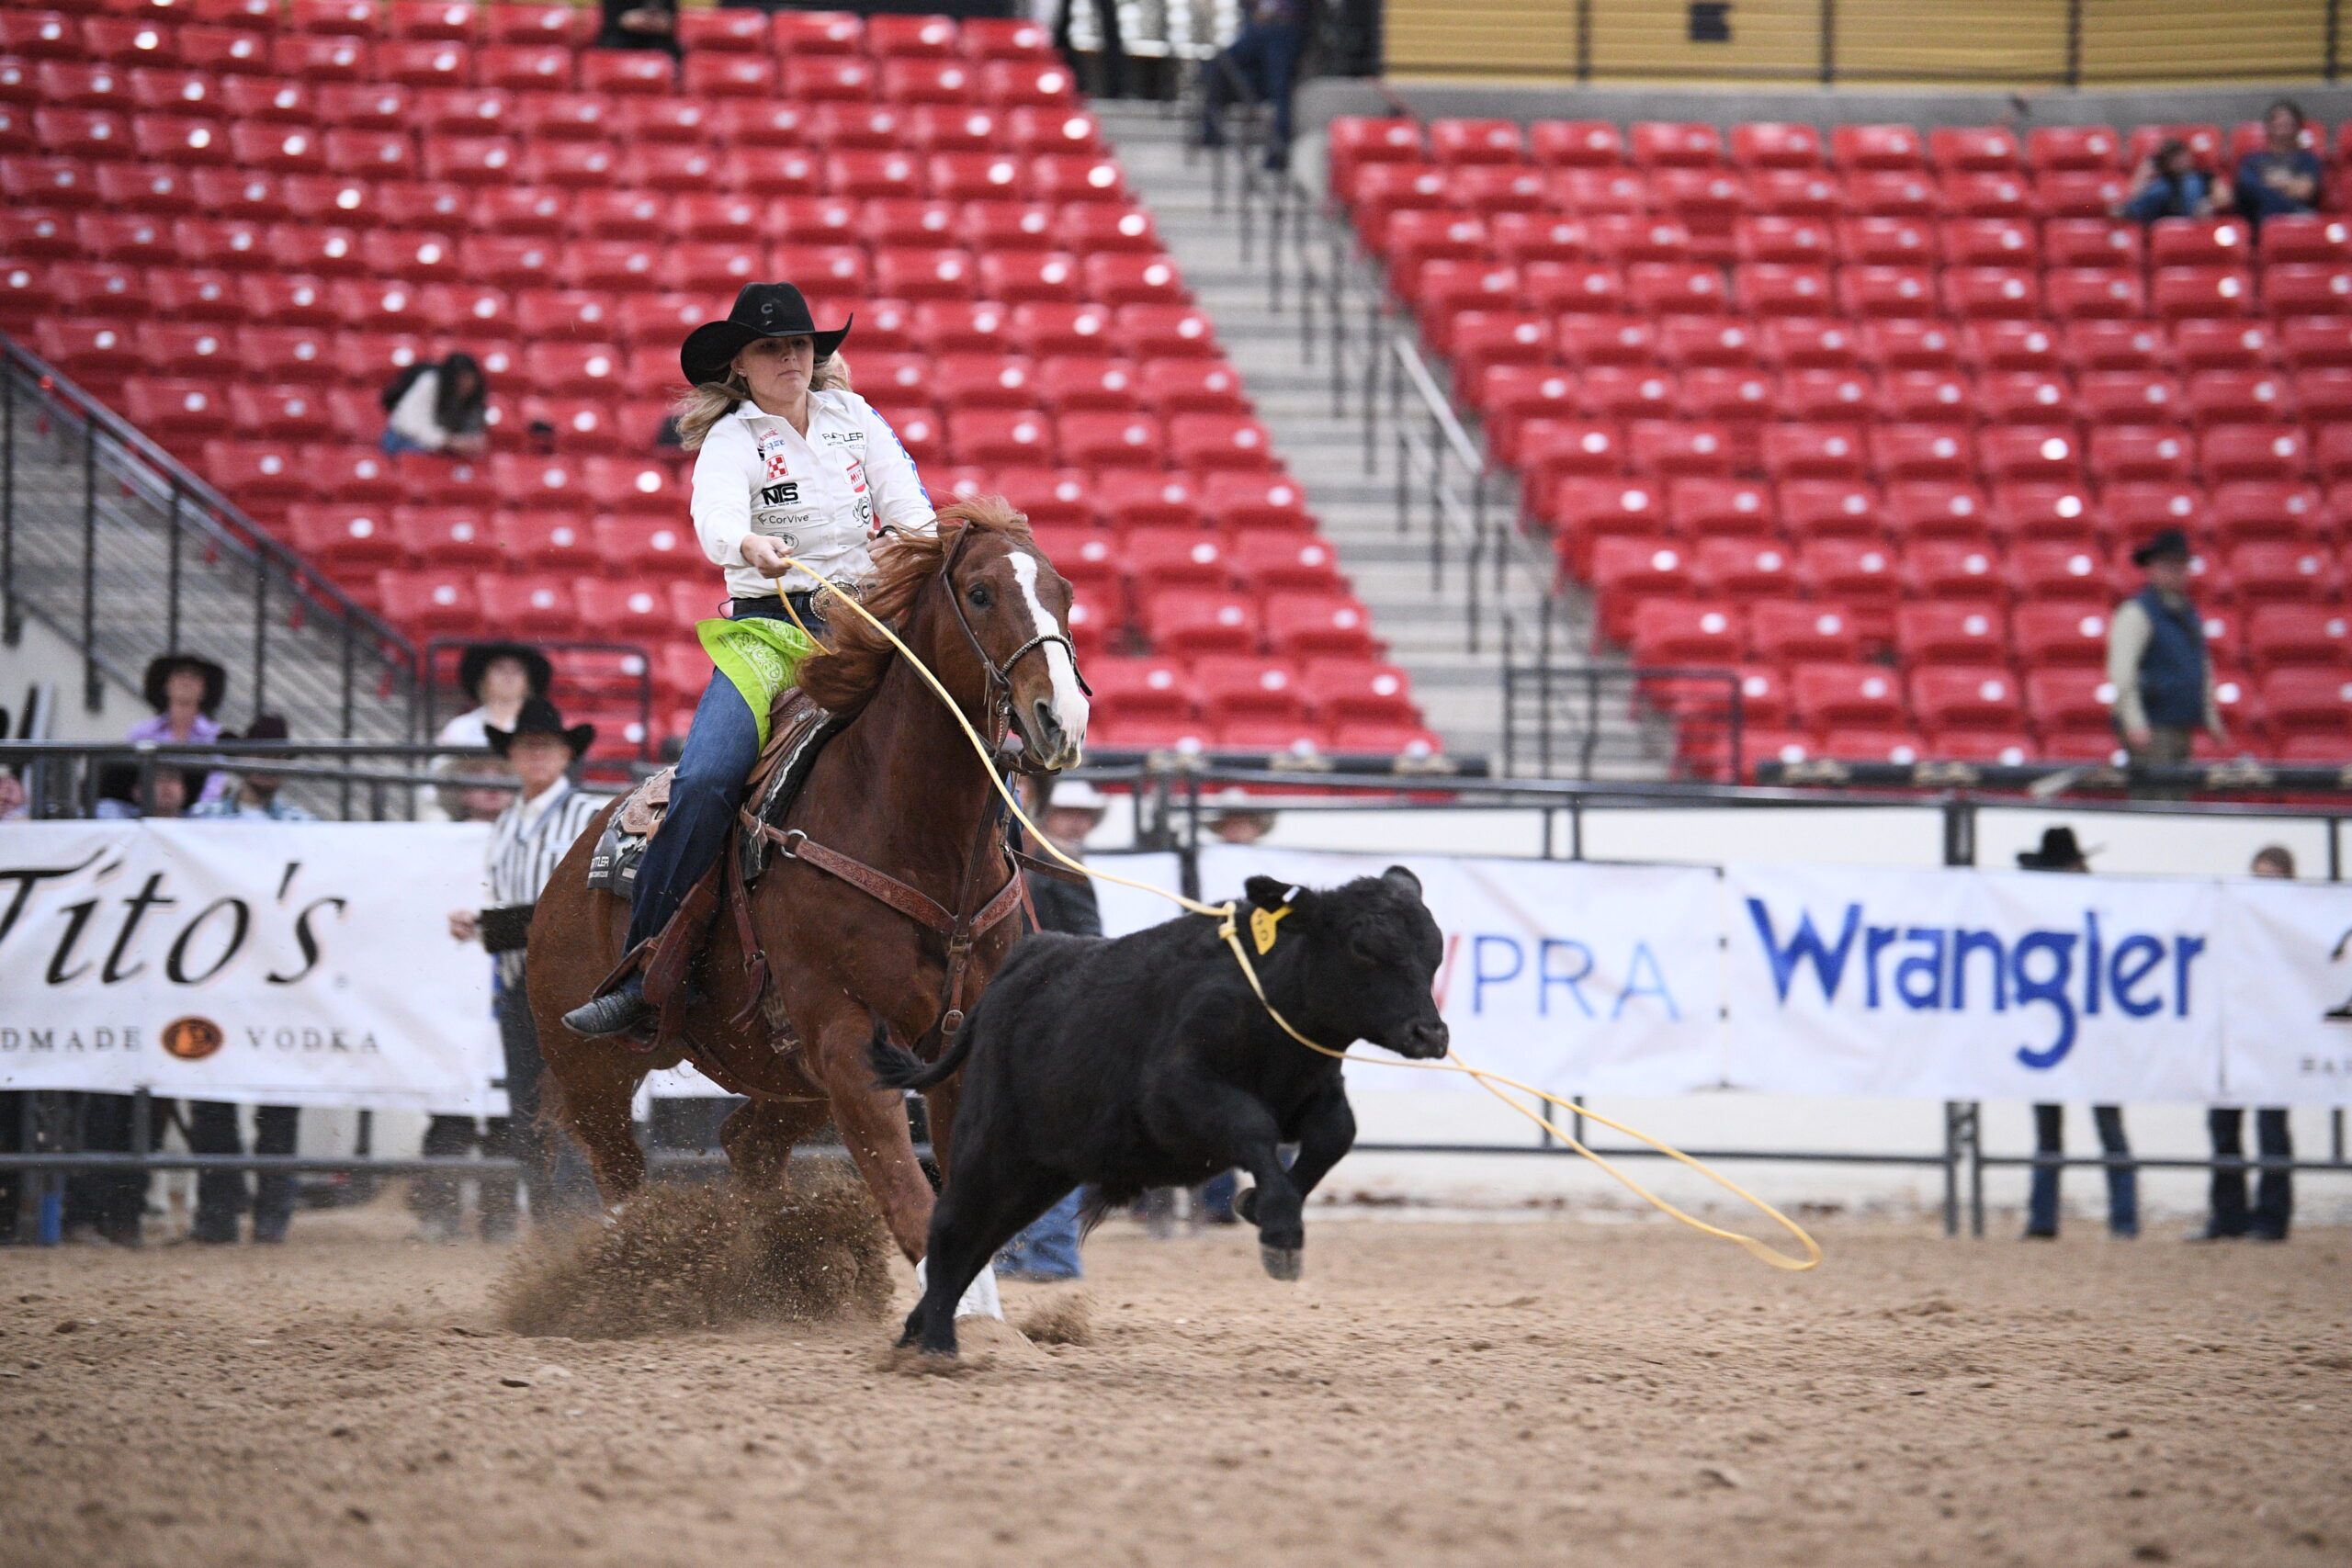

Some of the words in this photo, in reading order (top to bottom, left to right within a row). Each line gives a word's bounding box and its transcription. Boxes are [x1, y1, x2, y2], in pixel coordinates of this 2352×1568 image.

[761, 482, 798, 505] NTS
[769, 514, 809, 525] CorVive
[0, 847, 347, 985] Tito's
[1745, 897, 2207, 1069] Wrangler
[244, 1027, 380, 1052] VODKA
